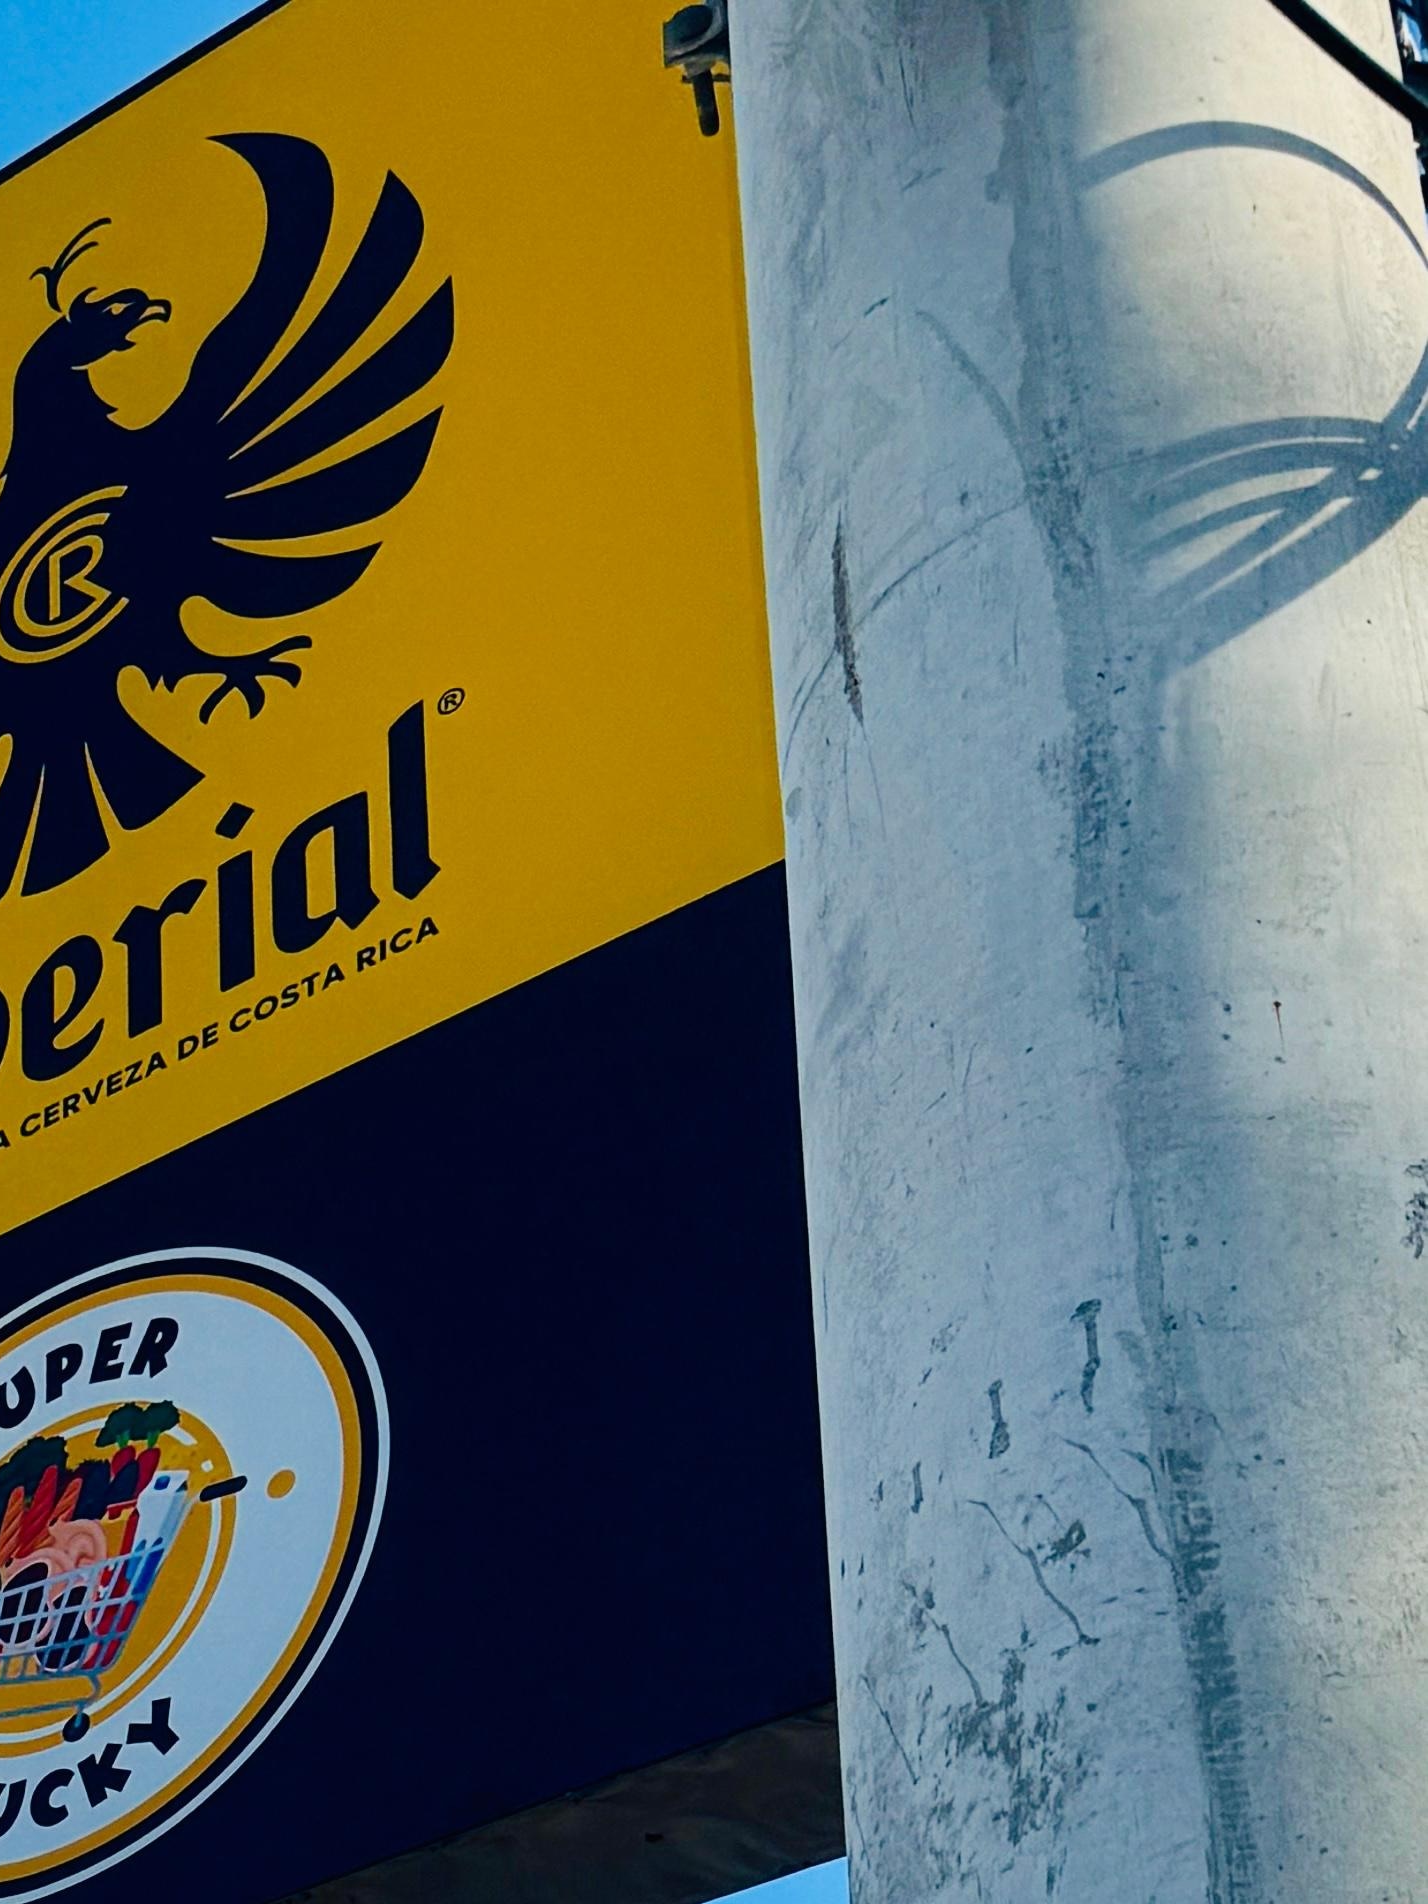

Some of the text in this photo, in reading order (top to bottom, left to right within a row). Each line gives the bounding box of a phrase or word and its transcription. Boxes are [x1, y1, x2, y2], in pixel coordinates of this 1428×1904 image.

[20, 1051, 168, 1137] CERVEZA
[177, 1023, 220, 1059] DE
[229, 962, 345, 1033] COSTA
[355, 917, 440, 972] RICA
